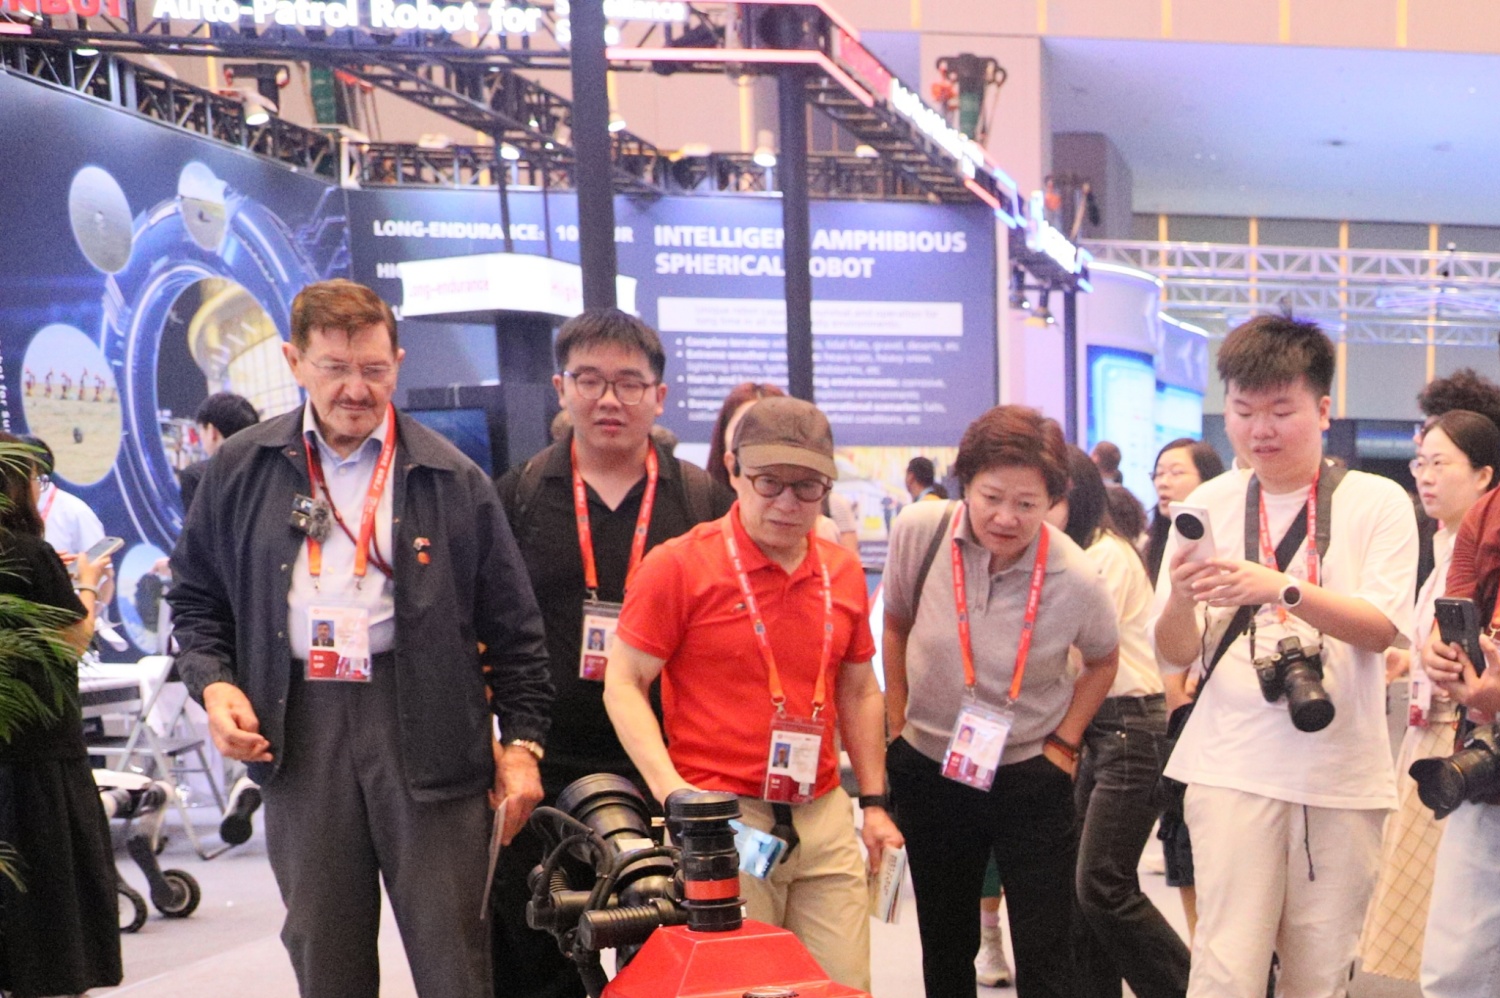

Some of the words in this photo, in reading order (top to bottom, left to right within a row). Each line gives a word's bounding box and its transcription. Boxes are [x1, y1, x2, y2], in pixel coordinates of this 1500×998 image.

[153, 0, 357, 27] Auto-Patrol
[371, 0, 479, 31] Robot
[488, 0, 542, 33] for
[653, 225, 785, 248] INTELLIGEN
[811, 229, 968, 253] AMPHIBIOUS
[655, 253, 786, 277] SPHERICAL
[808, 257, 876, 279] OBOT
